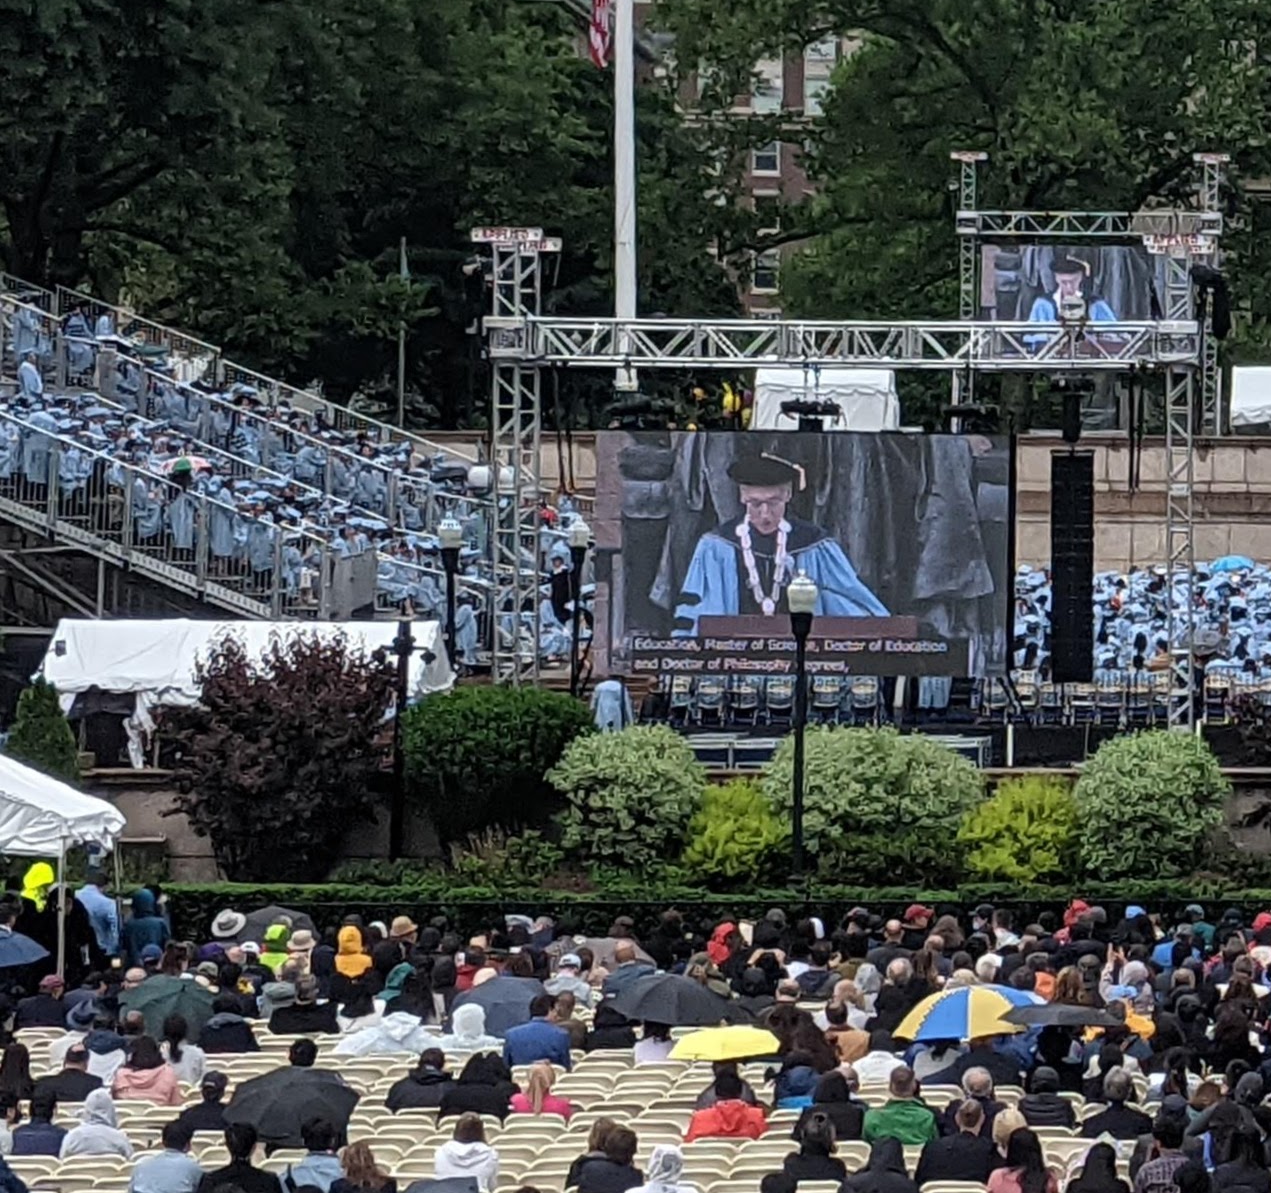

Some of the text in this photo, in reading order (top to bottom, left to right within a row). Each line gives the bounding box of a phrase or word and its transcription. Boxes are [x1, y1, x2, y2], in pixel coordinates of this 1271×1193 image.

[634, 638, 701, 652] Education,
[751, 639, 764, 651] of
[868, 640, 882, 652] of
[884, 640, 947, 653] Education
[634, 658, 659, 670] and
[661, 658, 705, 670] Doctor
[707, 658, 721, 670] of
[723, 658, 791, 674] Philosophy
